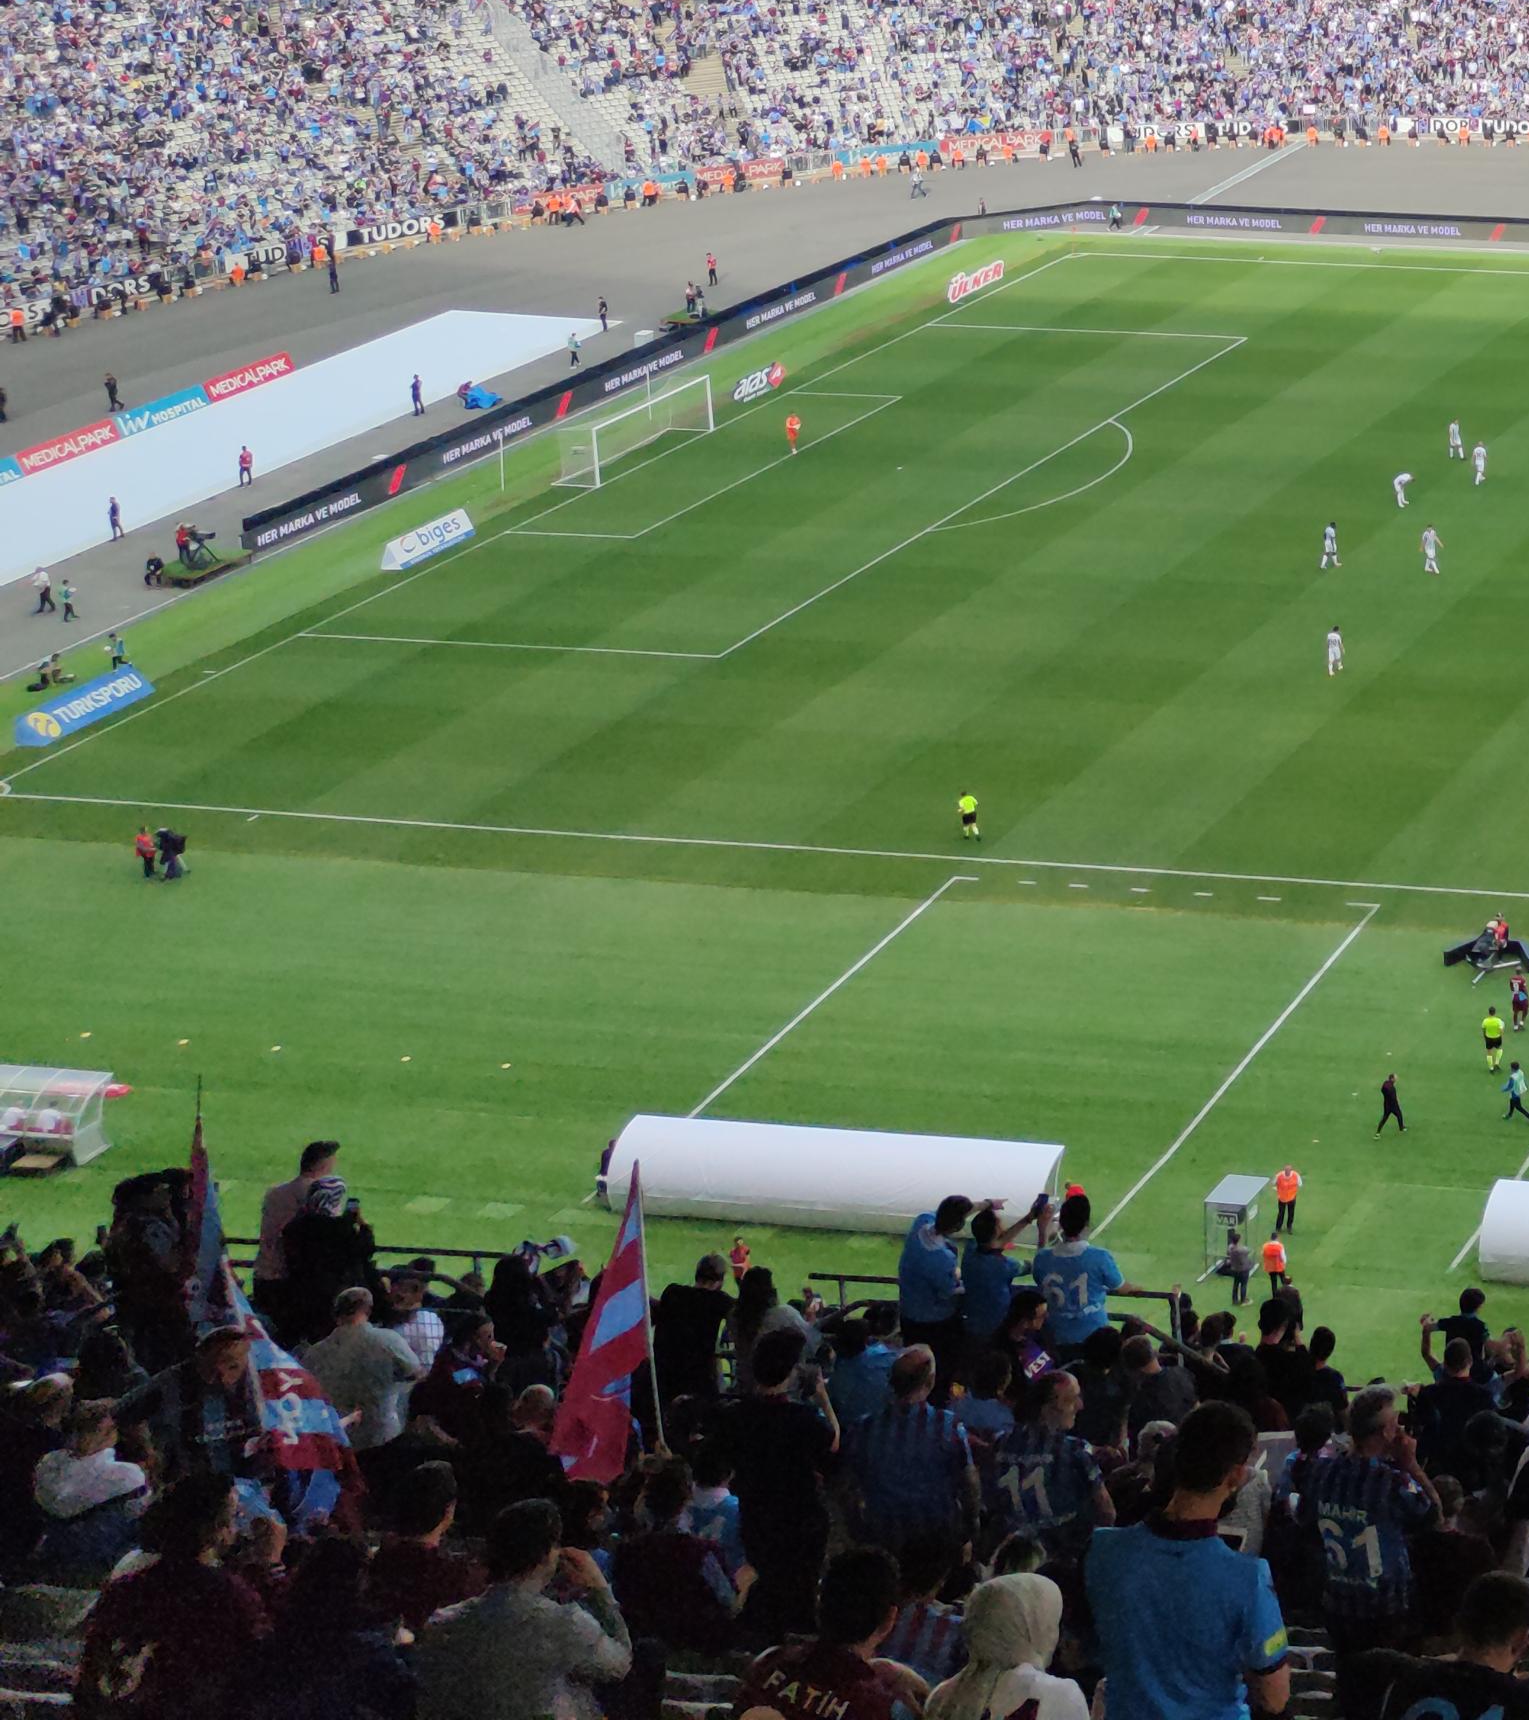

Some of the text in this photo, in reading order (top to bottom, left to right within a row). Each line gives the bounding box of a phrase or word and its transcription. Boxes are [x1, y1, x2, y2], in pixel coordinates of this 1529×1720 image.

[1003, 210, 1107, 230] HER MARKA VE MODEL
[1187, 215, 1282, 229] HER MARKA VE MODEL
[1364, 223, 1461, 237] HER MARKA VE MODEL
[912, 240, 934, 257] MODEL
[950, 261, 1003, 302] ÜLKER
[746, 291, 817, 330] HER MARKA VE MODEL
[604, 379, 621, 393] HER
[621, 366, 648, 385] MARKA
[659, 349, 684, 368] MODEL
[152, 396, 207, 425] HOSPITAL
[443, 447, 461, 464] HER
[461, 433, 491, 456] MARKA
[504, 416, 533, 435] MODEL
[257, 492, 362, 547] HER MARKA VE MODEL
[416, 518, 461, 546] biges
[1216, 1215, 1237, 1226] VAR
[1024, 1351, 1051, 1379] VEST
[999, 1465, 1053, 1517] 11
